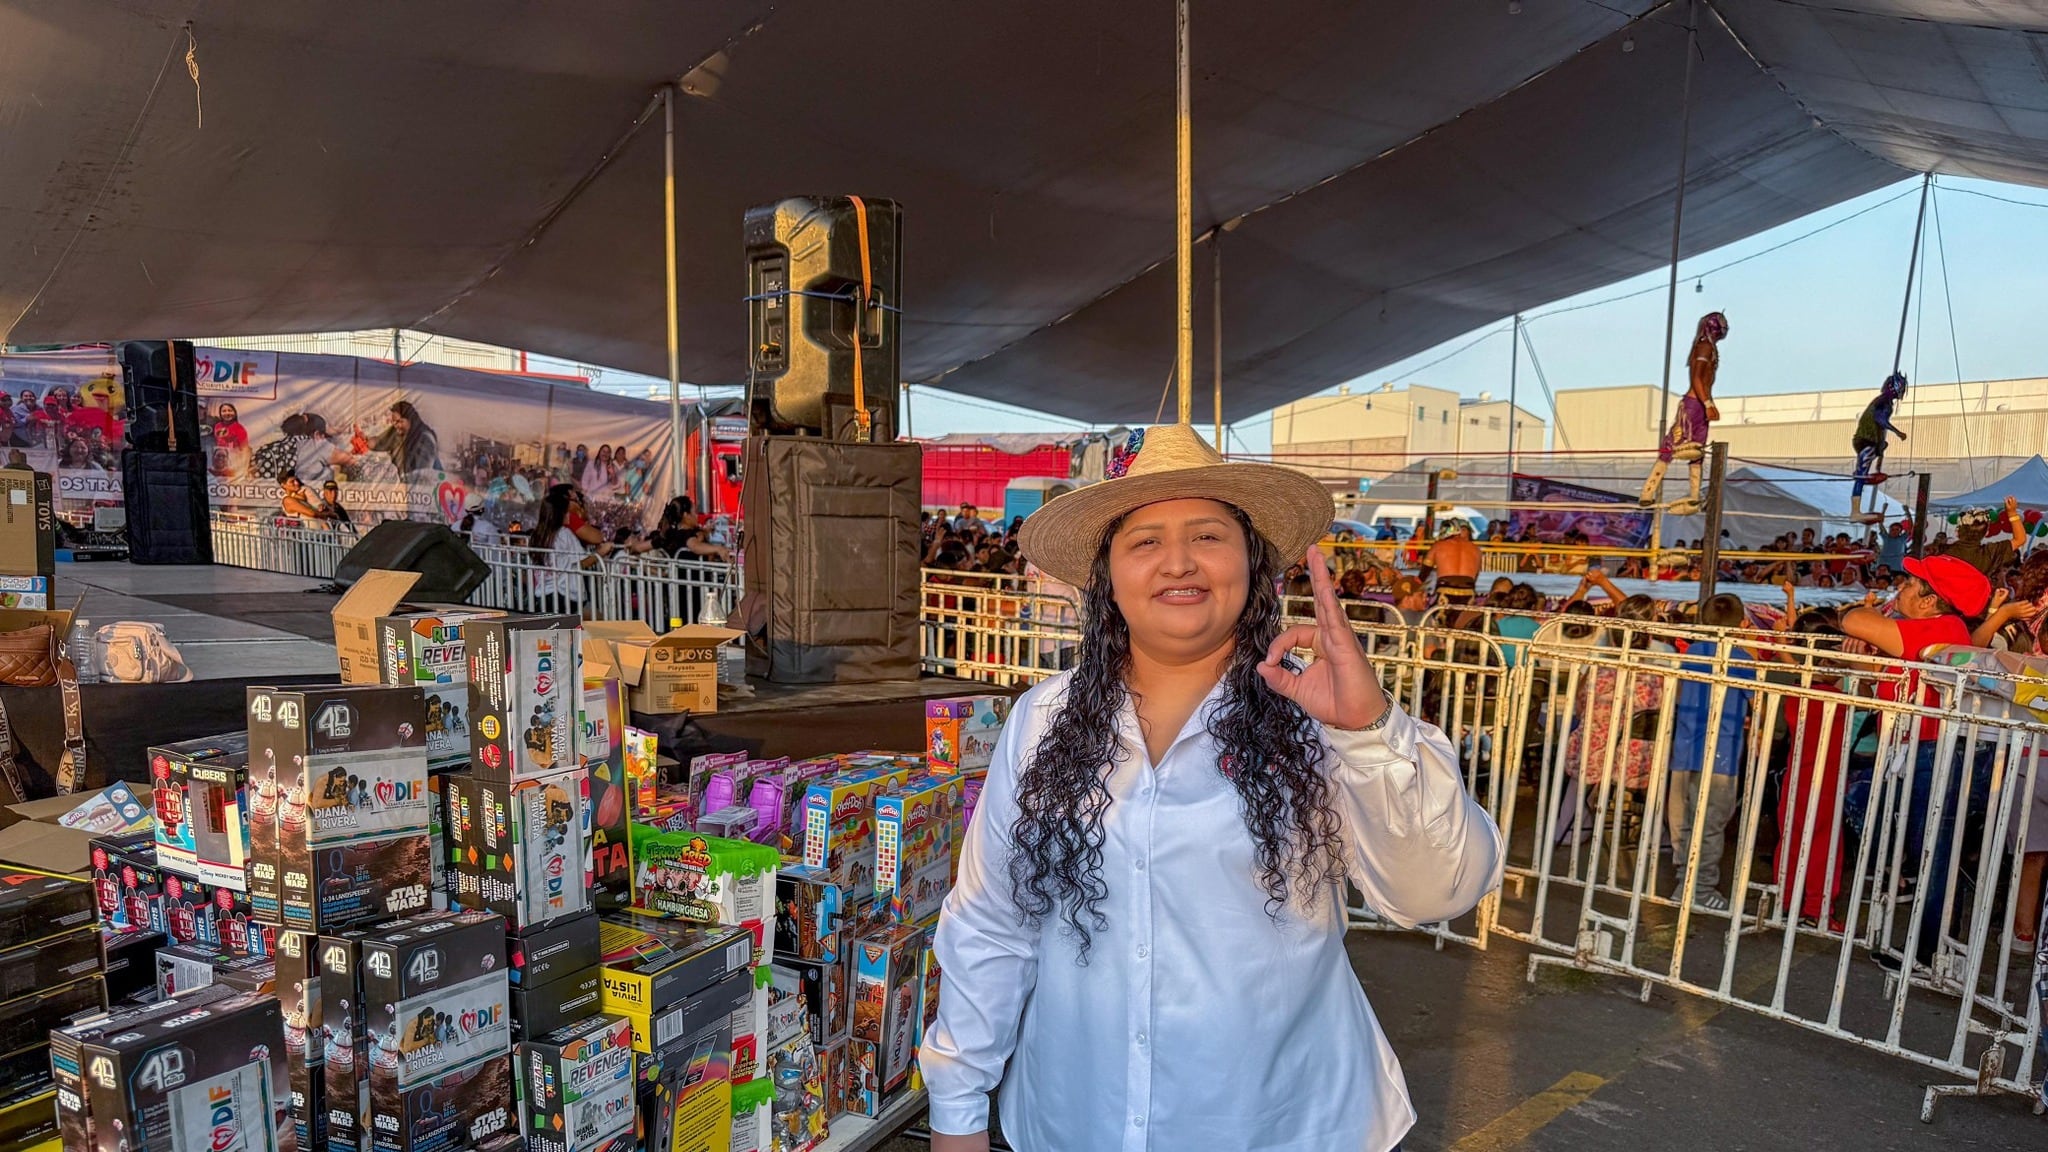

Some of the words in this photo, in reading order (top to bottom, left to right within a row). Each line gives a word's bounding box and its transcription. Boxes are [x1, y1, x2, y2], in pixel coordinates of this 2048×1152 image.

[213, 360, 258, 385] DIF
[60, 477, 84, 492] OS
[208, 484, 241, 498] CON
[245, 485, 263, 498] EL
[349, 489, 364, 503] EN
[367, 490, 386, 503] LA
[390, 491, 431, 505] MANO
[38, 500, 51, 530] TOYS
[537, 638, 552, 672] DIF
[585, 719, 604, 738] DIF
[193, 767, 227, 782] CUBERS
[395, 779, 423, 800] DIF
[314, 805, 347, 819] DIANA
[449, 783, 462, 842] REVENGE
[483, 788, 497, 849] REVENGE
[531, 801, 541, 840] RIVERA
[539, 792, 547, 830] DIANA
[322, 816, 357, 829] RIVERA
[593, 828, 608, 847] A
[254, 863, 274, 875] STAR
[593, 842, 628, 878] TA
[254, 868, 276, 880] WARS
[284, 872, 307, 884] STAR
[284, 878, 308, 889] WARS
[391, 884, 428, 900] STAR
[548, 877, 563, 908] DIF
[386, 893, 428, 913] WARS
[656, 898, 709, 919] HAMBURGUESA
[603, 977, 637, 995] LISTA
[478, 1003, 503, 1029] DIF
[406, 1044, 435, 1063] DIANA
[578, 1033, 616, 1063] RUBIK'S
[413, 1052, 444, 1071] RIVERA
[569, 1047, 628, 1089] REVENGE
[532, 1050, 546, 1109] REVENGE
[291, 1091, 304, 1100] AR
[615, 1095, 630, 1112] DIF
[208, 1086, 234, 1127] DIF
[330, 1109, 353, 1121] STAR
[330, 1116, 353, 1127] WARS
[374, 1114, 399, 1124] STAR
[374, 1120, 400, 1132] WARS
[475, 1107, 507, 1127] STAR
[471, 1116, 507, 1141] WARS
[576, 1123, 594, 1137] DIANA
[580, 1128, 599, 1143] RIVERA
